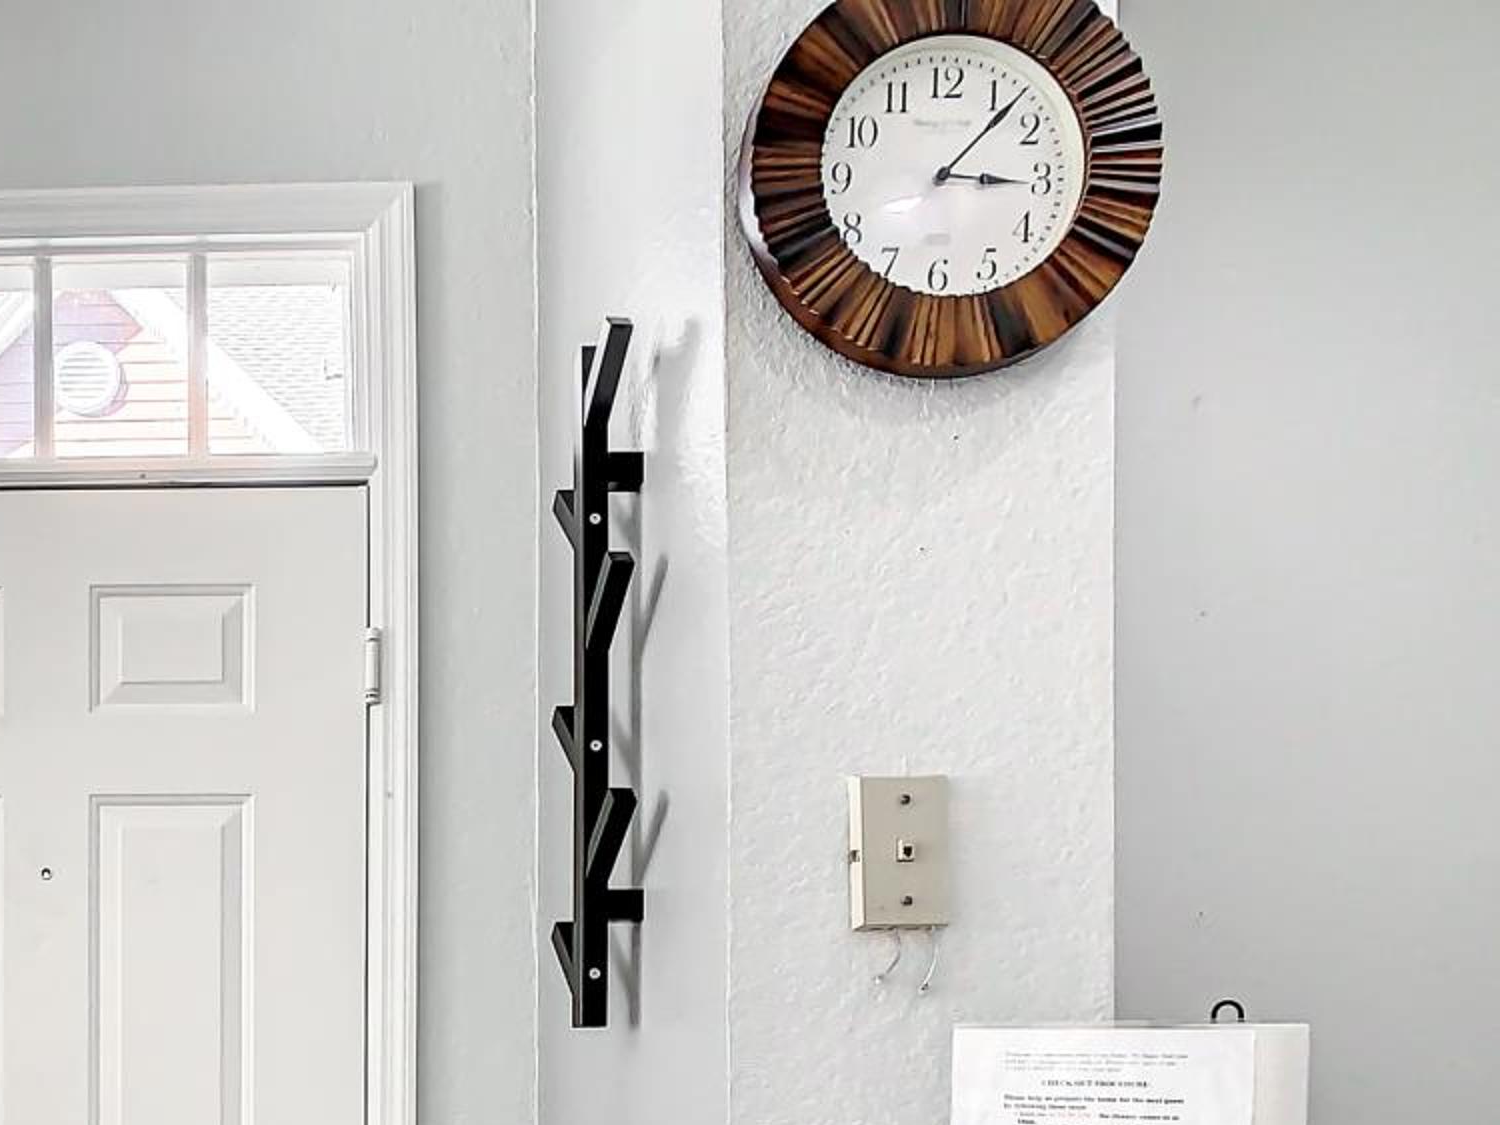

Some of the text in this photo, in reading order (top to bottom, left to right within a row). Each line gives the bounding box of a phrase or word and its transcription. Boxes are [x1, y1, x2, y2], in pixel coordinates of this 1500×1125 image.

[884, 81, 909, 113] 11
[929, 67, 963, 99] 12
[989, 79, 999, 110] 1
[847, 117, 878, 147] 10
[1020, 116, 1041, 145] 2
[831, 162, 852, 194] 9
[1031, 162, 1051, 196] 3
[843, 212, 862, 244] 8
[1013, 211, 1034, 243] 4
[880, 248, 899, 276] 7
[928, 259, 949, 291] 6
[977, 248, 998, 280] 5
